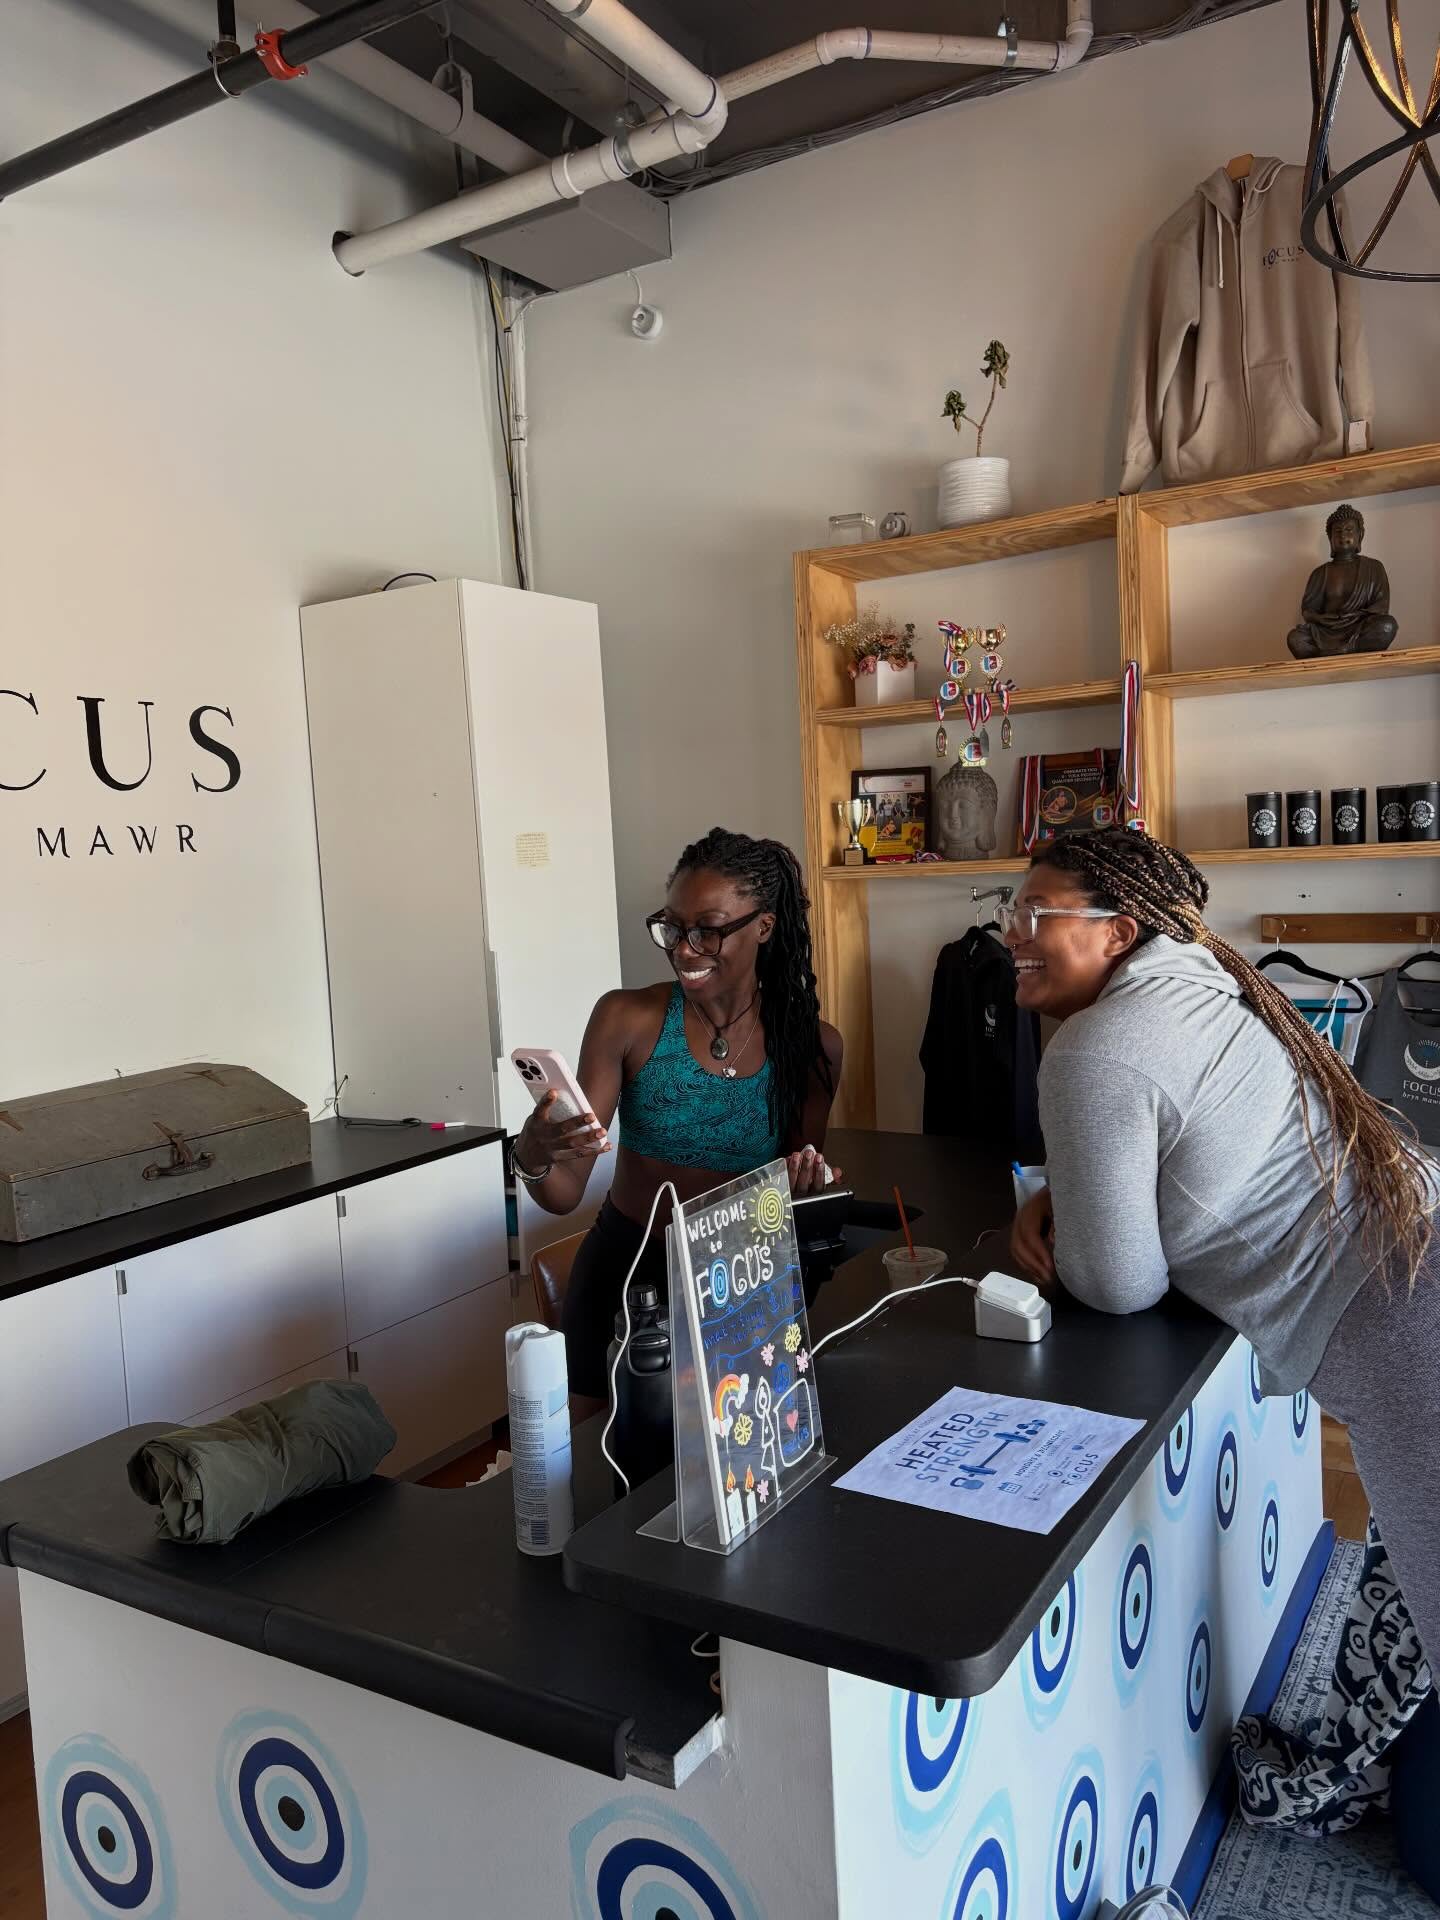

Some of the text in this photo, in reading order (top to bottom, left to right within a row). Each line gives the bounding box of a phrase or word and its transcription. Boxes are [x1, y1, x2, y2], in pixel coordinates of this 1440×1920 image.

[37, 824, 198, 858] MAWR
[686, 1200, 747, 1243] WELCOME
[710, 1240, 723, 1254] to
[696, 1244, 774, 1318] FOCUS
[896, 1413, 975, 1470] HEATED
[915, 1411, 1009, 1483] STRENGTH
[1061, 1453, 1099, 1486] FOCUS
